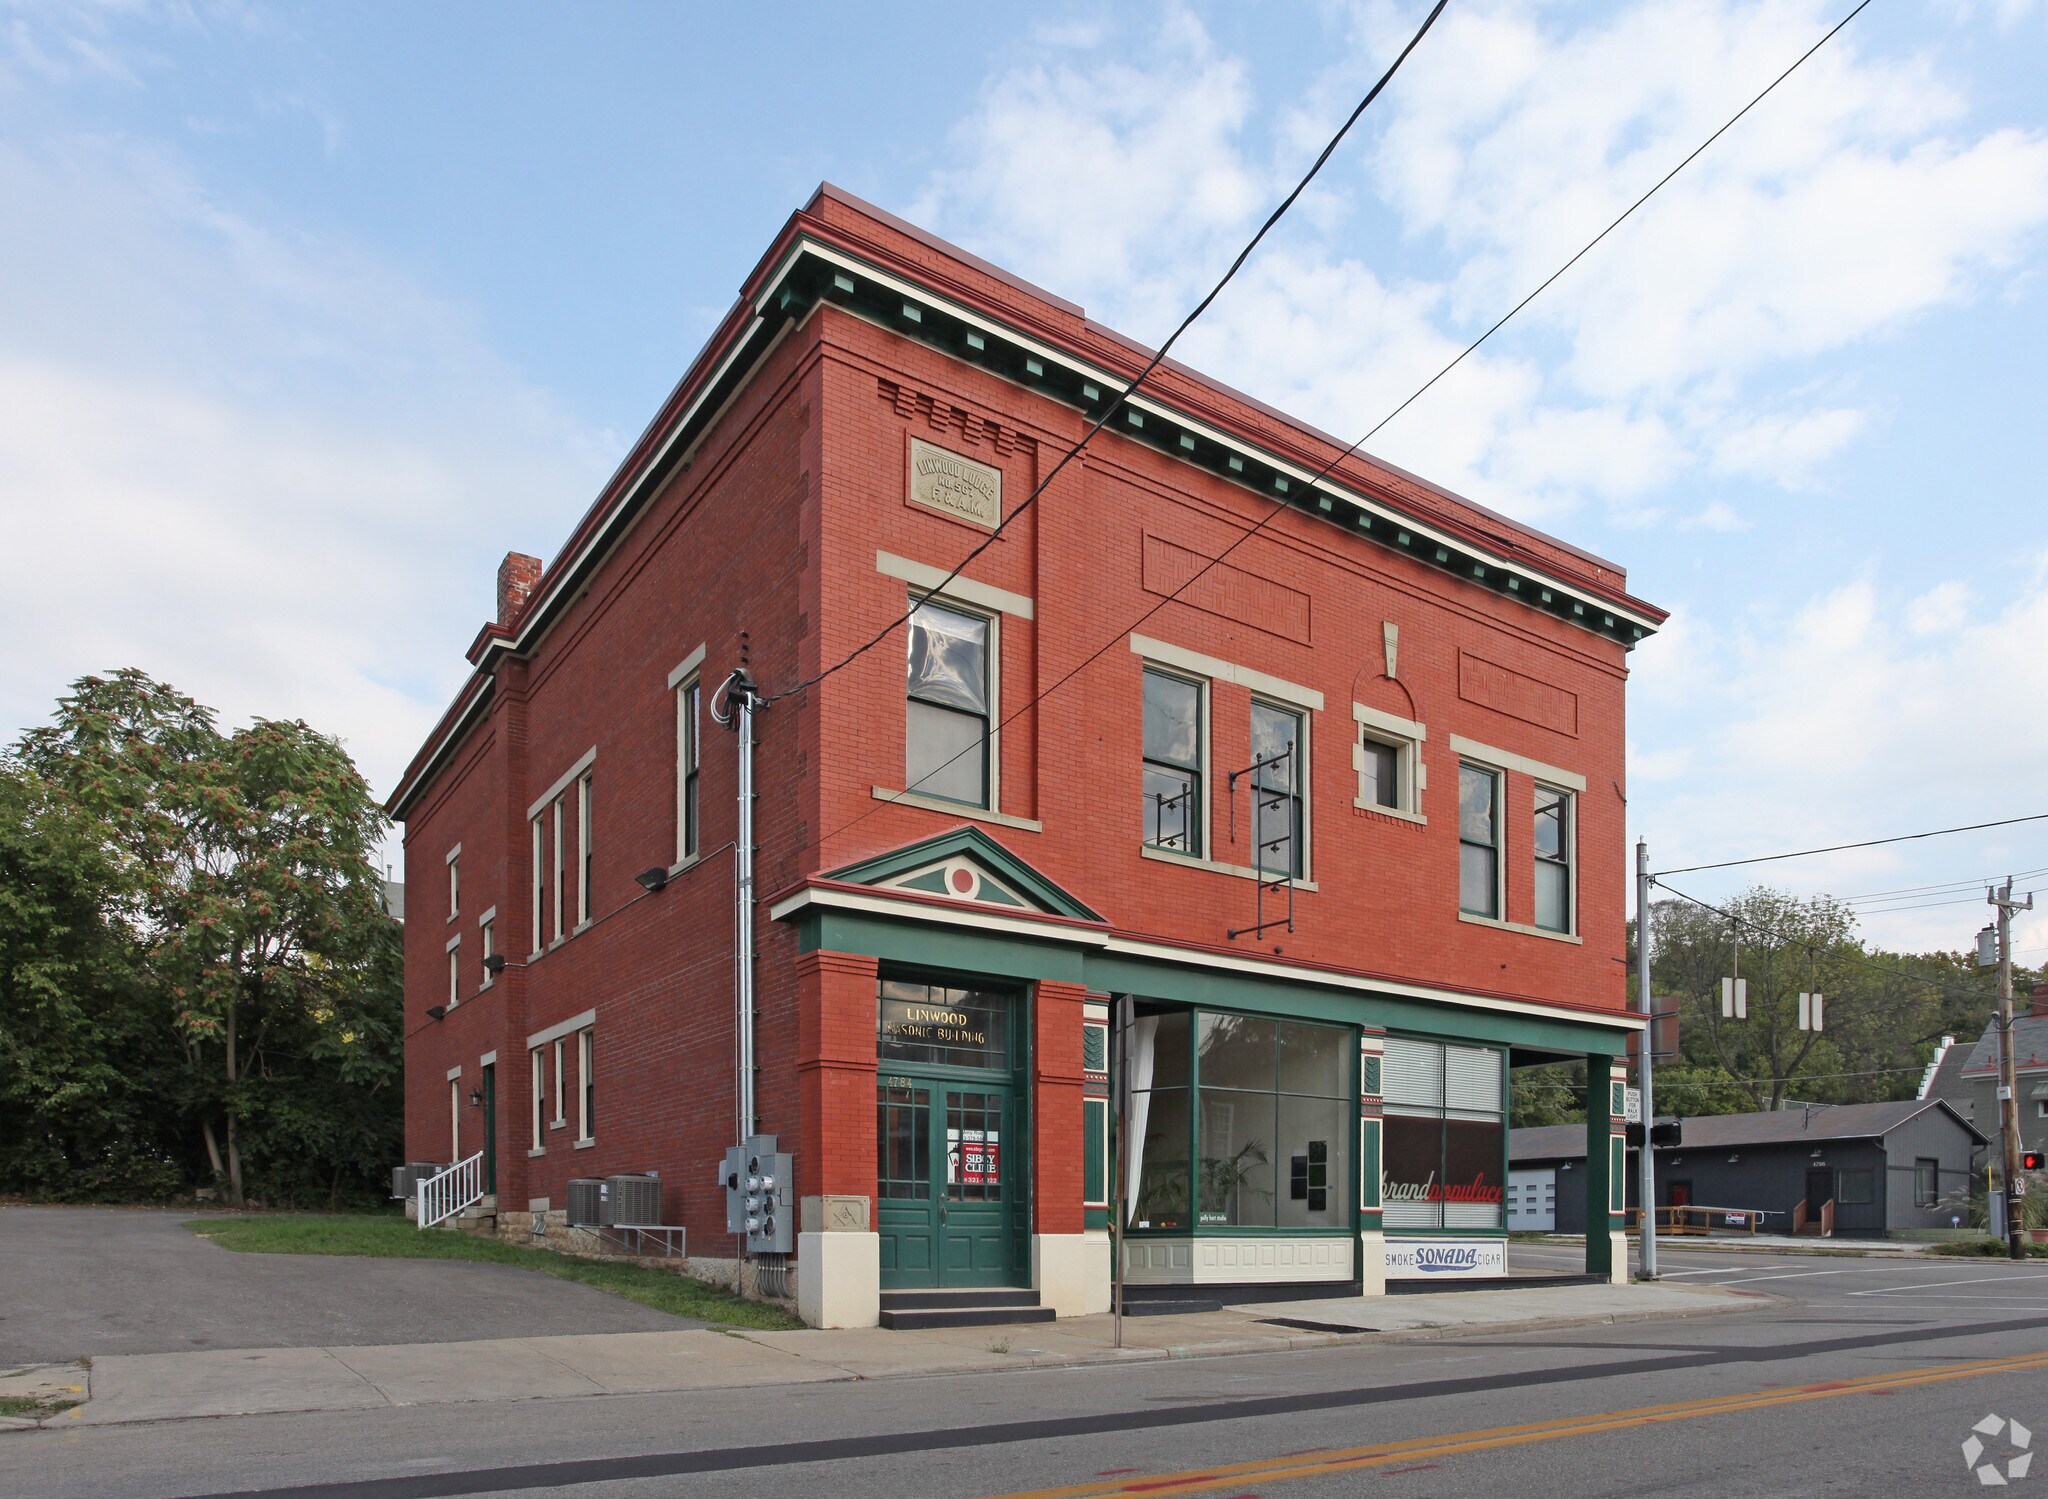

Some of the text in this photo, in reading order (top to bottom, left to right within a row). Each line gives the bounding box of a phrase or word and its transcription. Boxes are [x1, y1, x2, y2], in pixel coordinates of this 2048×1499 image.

[916, 459, 994, 501] LINWOOD LODGE
[907, 1008, 967, 1026] LINWOOD
[887, 1023, 985, 1044] MASONIC BUILDING
[888, 1077, 912, 1088] 4784
[1386, 1248, 1501, 1266] SMOKE SONADA CIGAR
